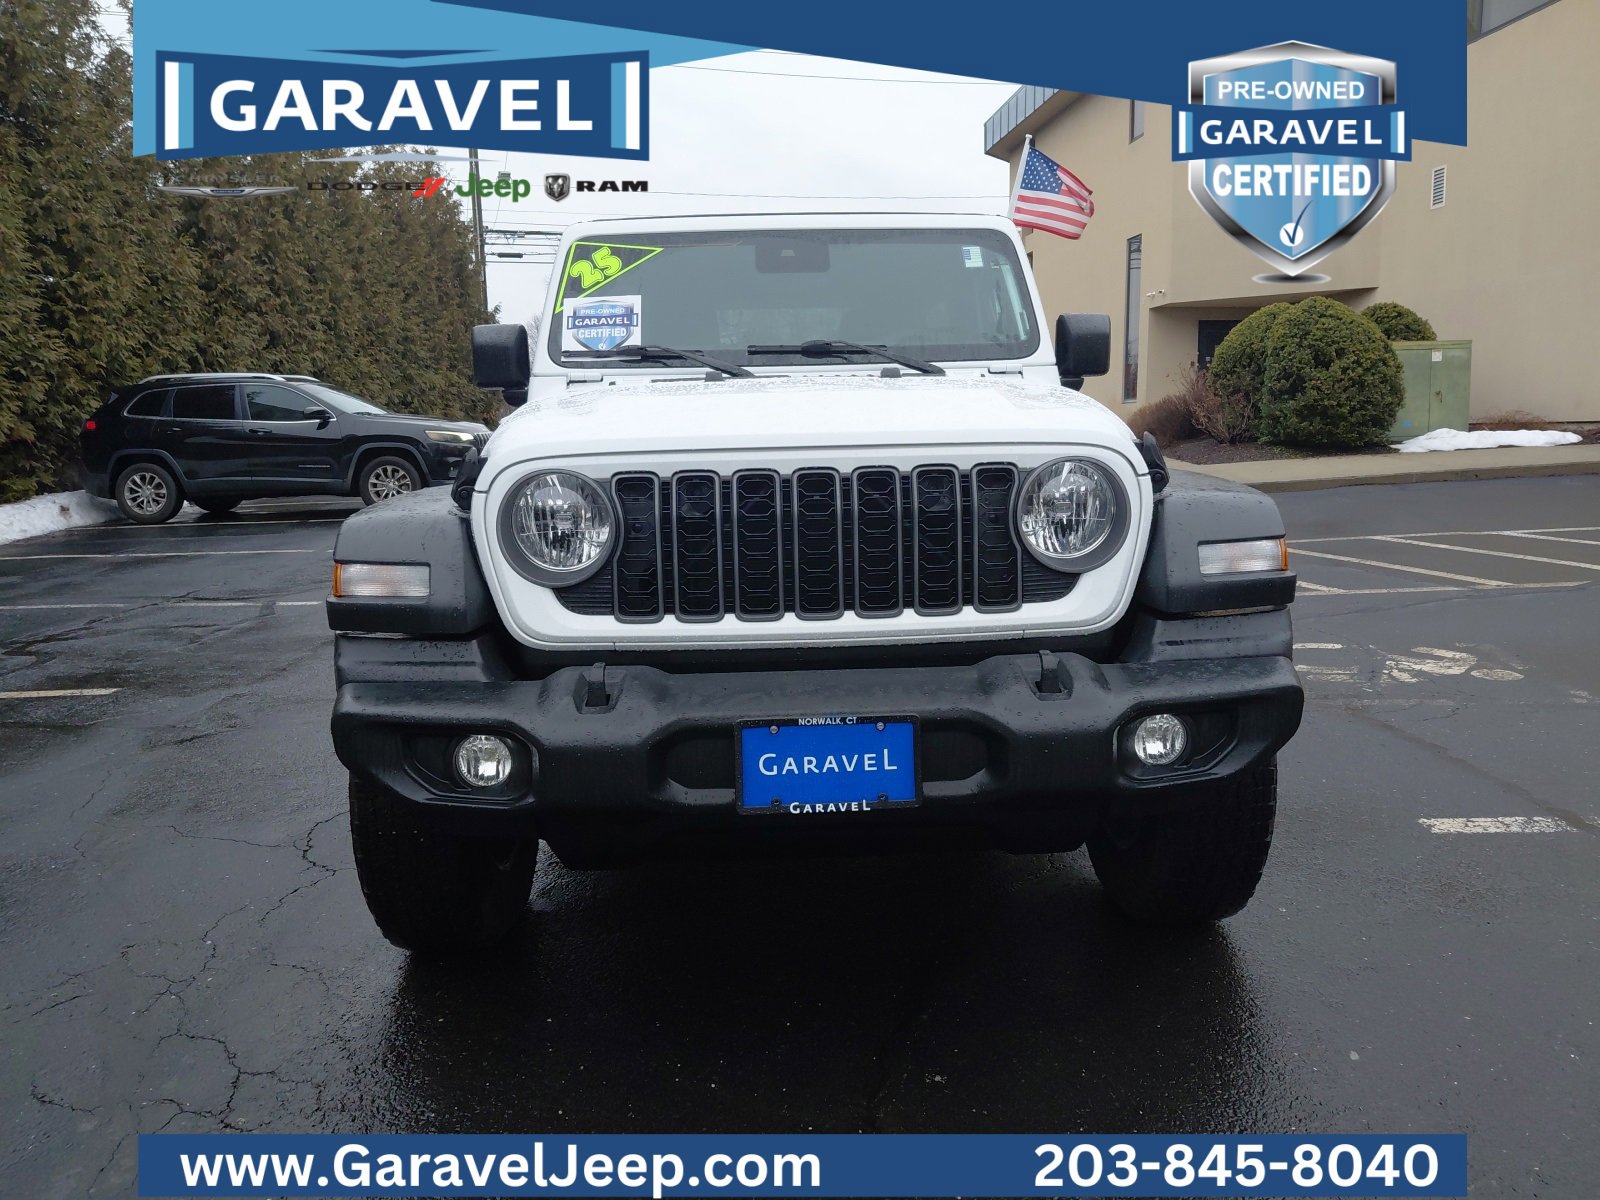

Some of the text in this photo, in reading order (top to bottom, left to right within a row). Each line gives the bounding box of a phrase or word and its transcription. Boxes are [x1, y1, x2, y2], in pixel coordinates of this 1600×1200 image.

[569, 246, 622, 289] 25
[580, 307, 625, 315] PRE-OWNED
[575, 317, 631, 326] GARAVEL
[578, 328, 627, 339] CERTIFIED
[798, 716, 857, 726] NORWALK, CT
